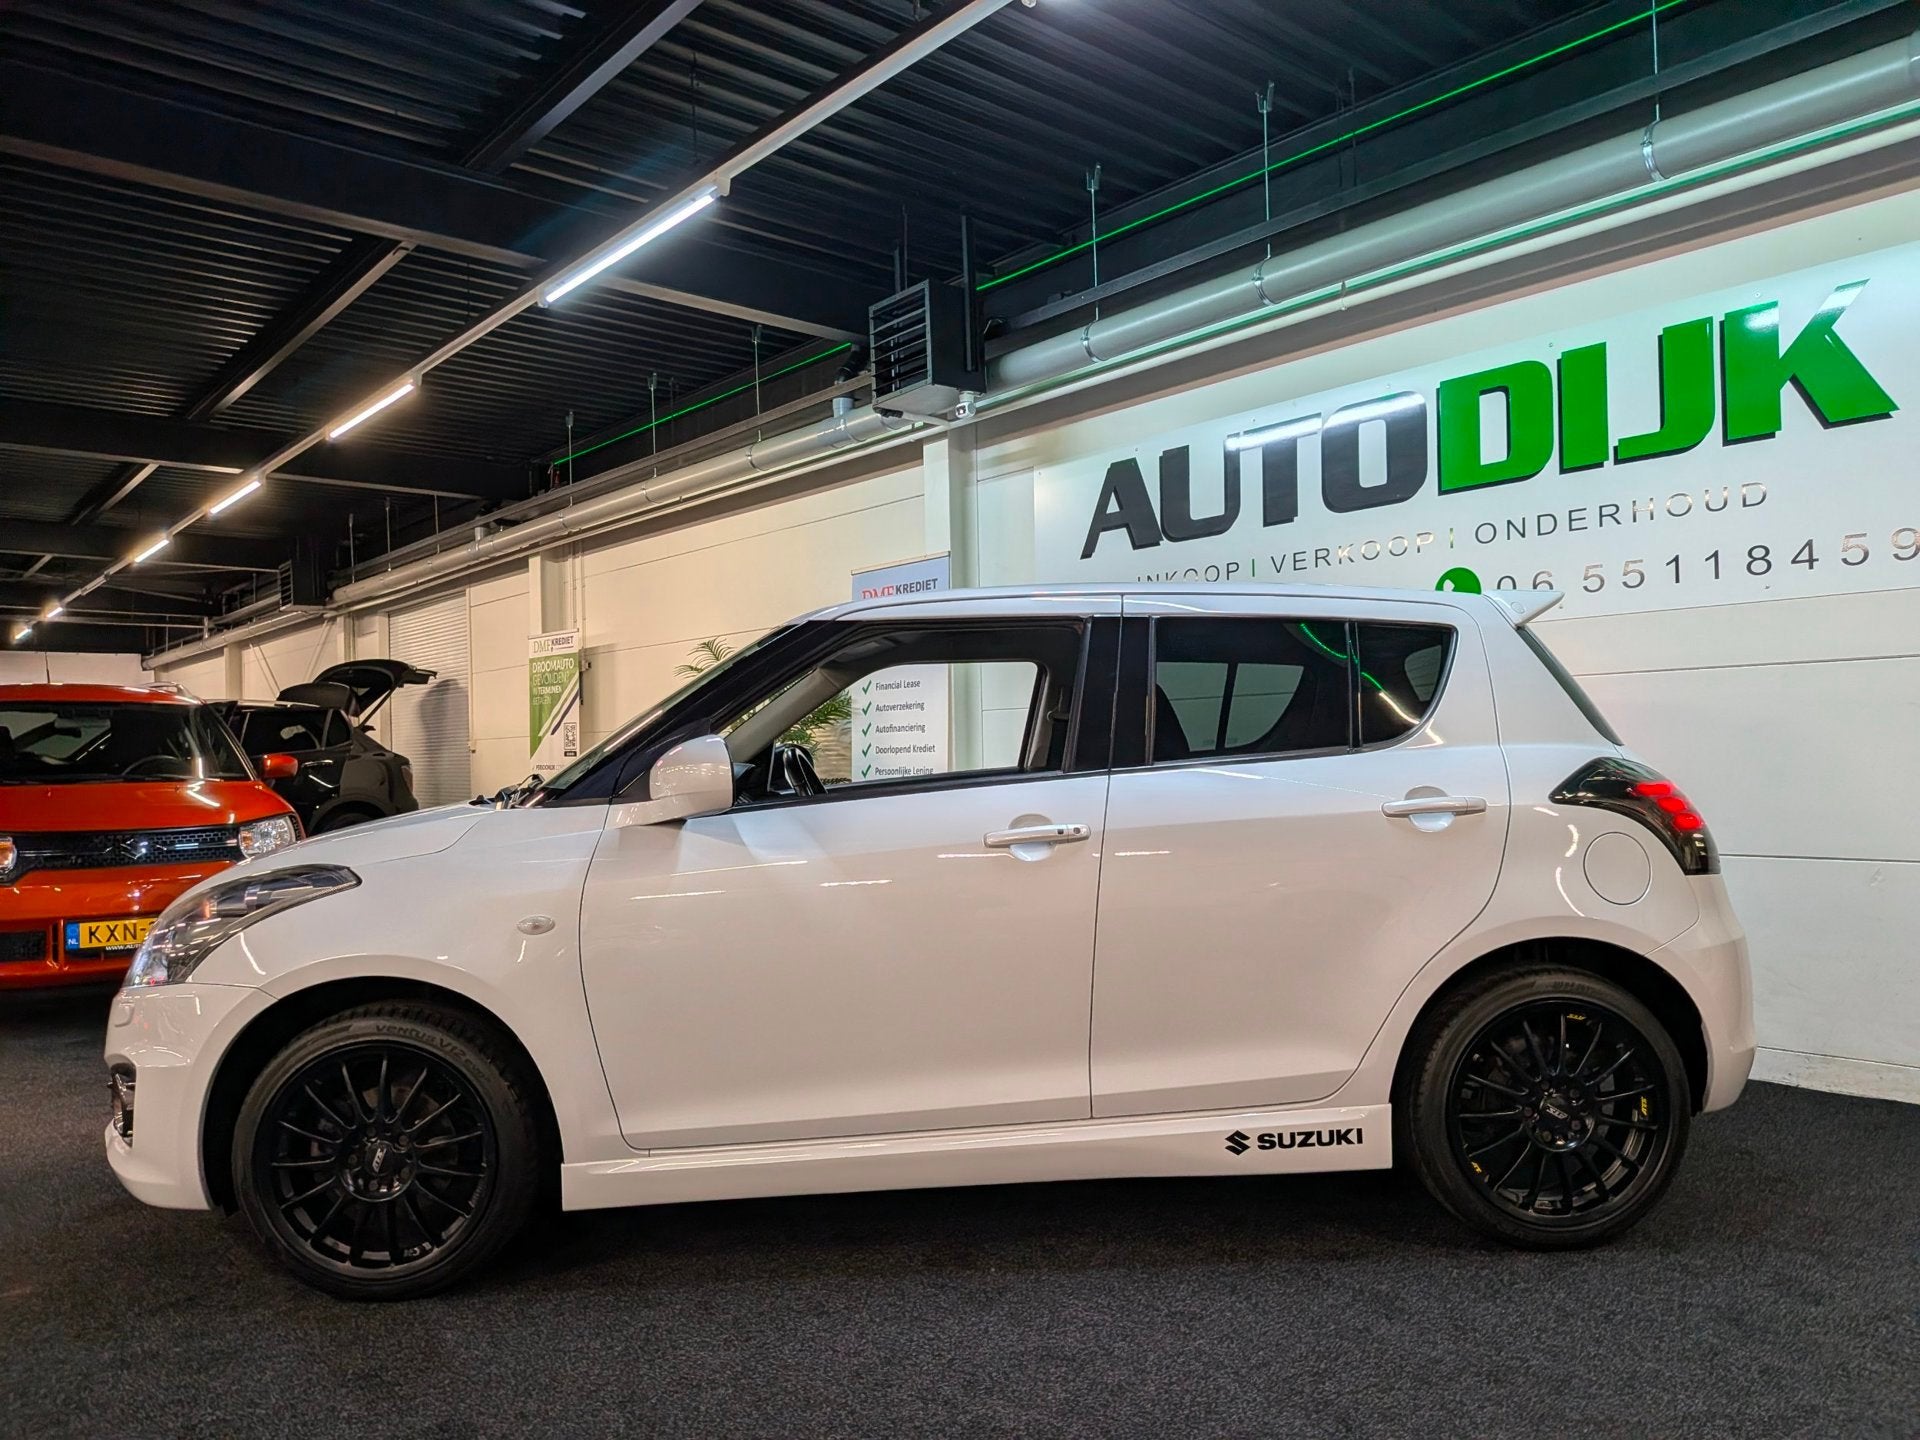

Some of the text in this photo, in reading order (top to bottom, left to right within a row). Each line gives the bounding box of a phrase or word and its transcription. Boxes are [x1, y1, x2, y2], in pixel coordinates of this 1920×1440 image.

[1080, 278, 1900, 560] AUTODIJK
[1270, 531, 1434, 574] VERKOOP
[1474, 481, 1768, 545] ONDERHOUD
[1581, 526, 1920, 594] 55118459
[895, 578, 938, 595] KREDIET
[551, 635, 574, 646] KREDIET
[532, 658, 575, 673] DROOMAUTO
[875, 679, 921, 691] Financial Lease
[875, 701, 925, 712] Autoverzekering
[875, 723, 926, 734] Autofinanciering
[875, 743, 936, 755] Doorlopend Krediet
[874, 766, 911, 778] Persoonlijke
[1256, 1128, 1364, 1151] SUZUKI
